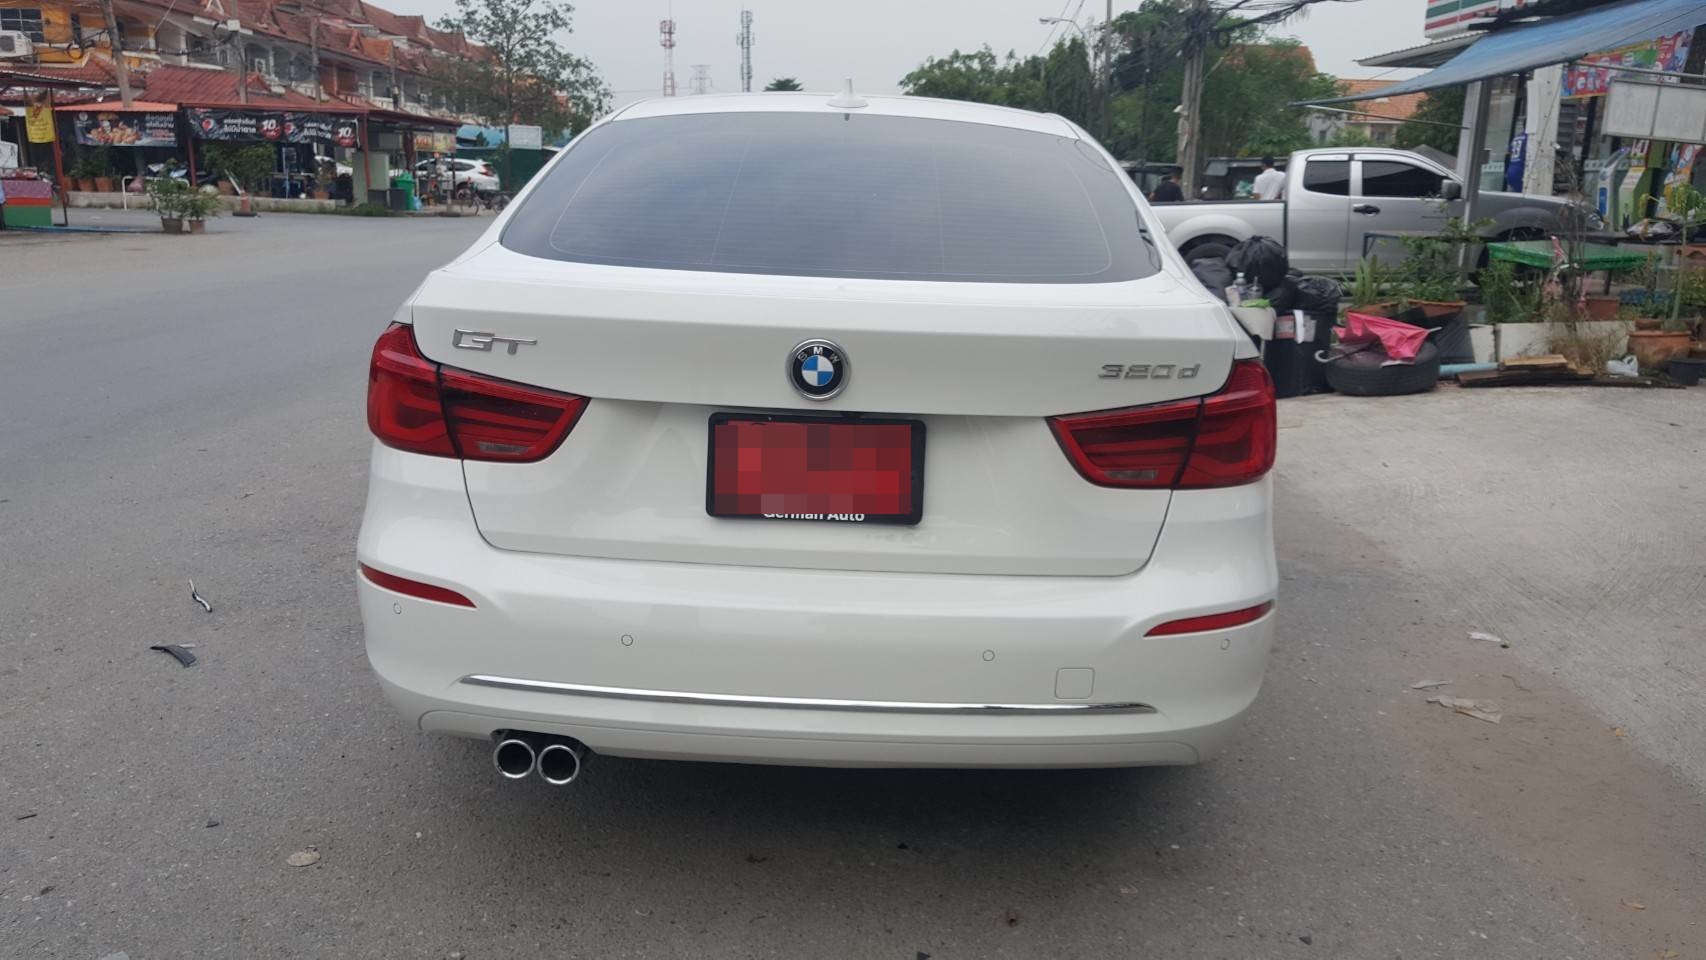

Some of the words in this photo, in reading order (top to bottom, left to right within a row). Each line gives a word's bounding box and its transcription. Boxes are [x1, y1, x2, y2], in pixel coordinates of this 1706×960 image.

[452, 328, 538, 355] GT
[797, 346, 840, 363] BMW
[1098, 363, 1201, 379] 320d
